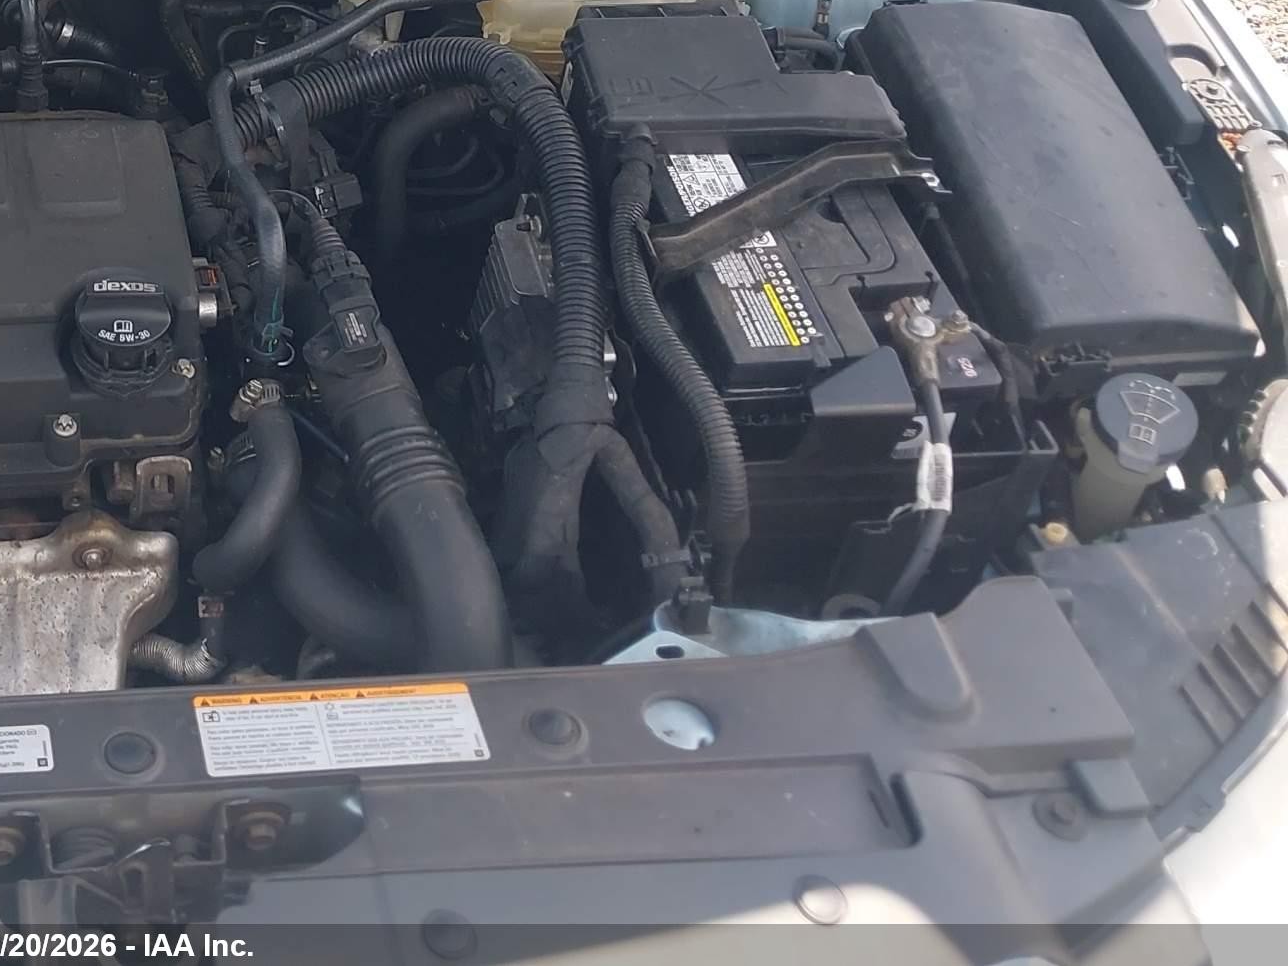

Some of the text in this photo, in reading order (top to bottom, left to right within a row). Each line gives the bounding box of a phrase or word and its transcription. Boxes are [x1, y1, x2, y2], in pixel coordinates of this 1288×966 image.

[93, 279, 157, 292] dexos
[98, 329, 151, 343] SAE 5W-30
